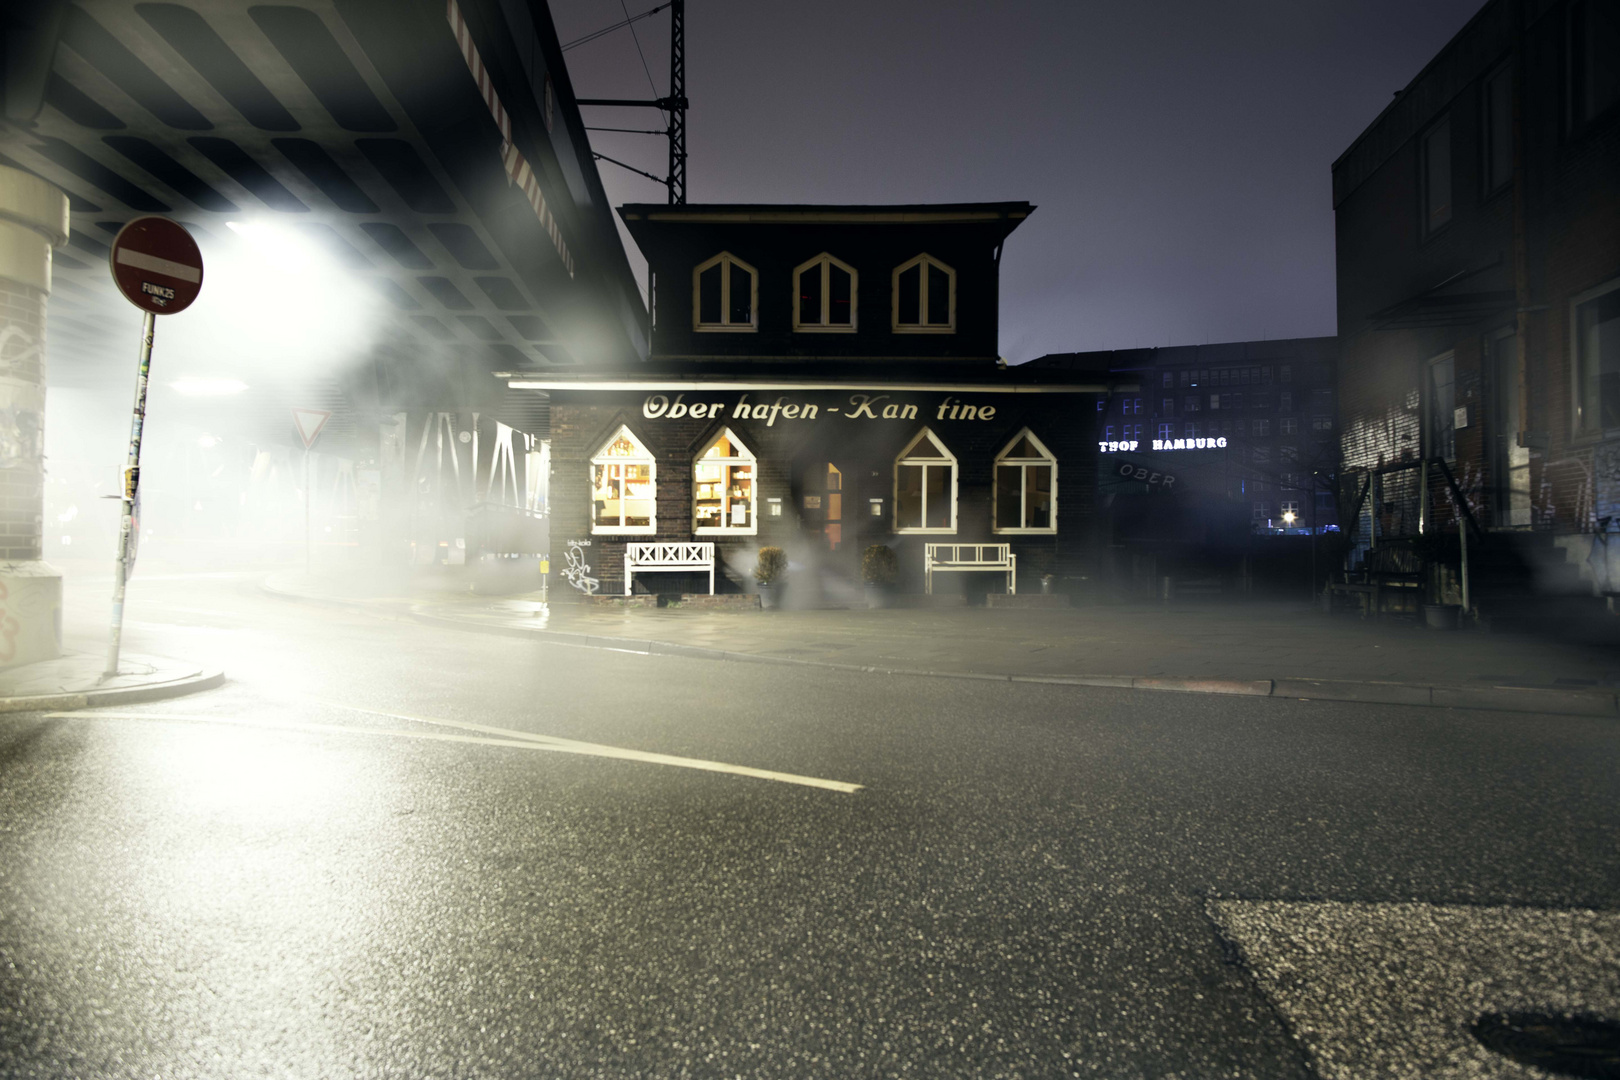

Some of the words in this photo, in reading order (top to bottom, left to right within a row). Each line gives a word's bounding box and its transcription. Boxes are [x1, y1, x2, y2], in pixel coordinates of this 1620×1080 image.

[643, 394, 725, 419] Ober
[732, 394, 818, 427] hafen
[844, 394, 918, 419] Kan
[936, 396, 997, 421] tine
[1152, 437, 1227, 450] HAMBURG
[1120, 464, 1175, 487] OBER
